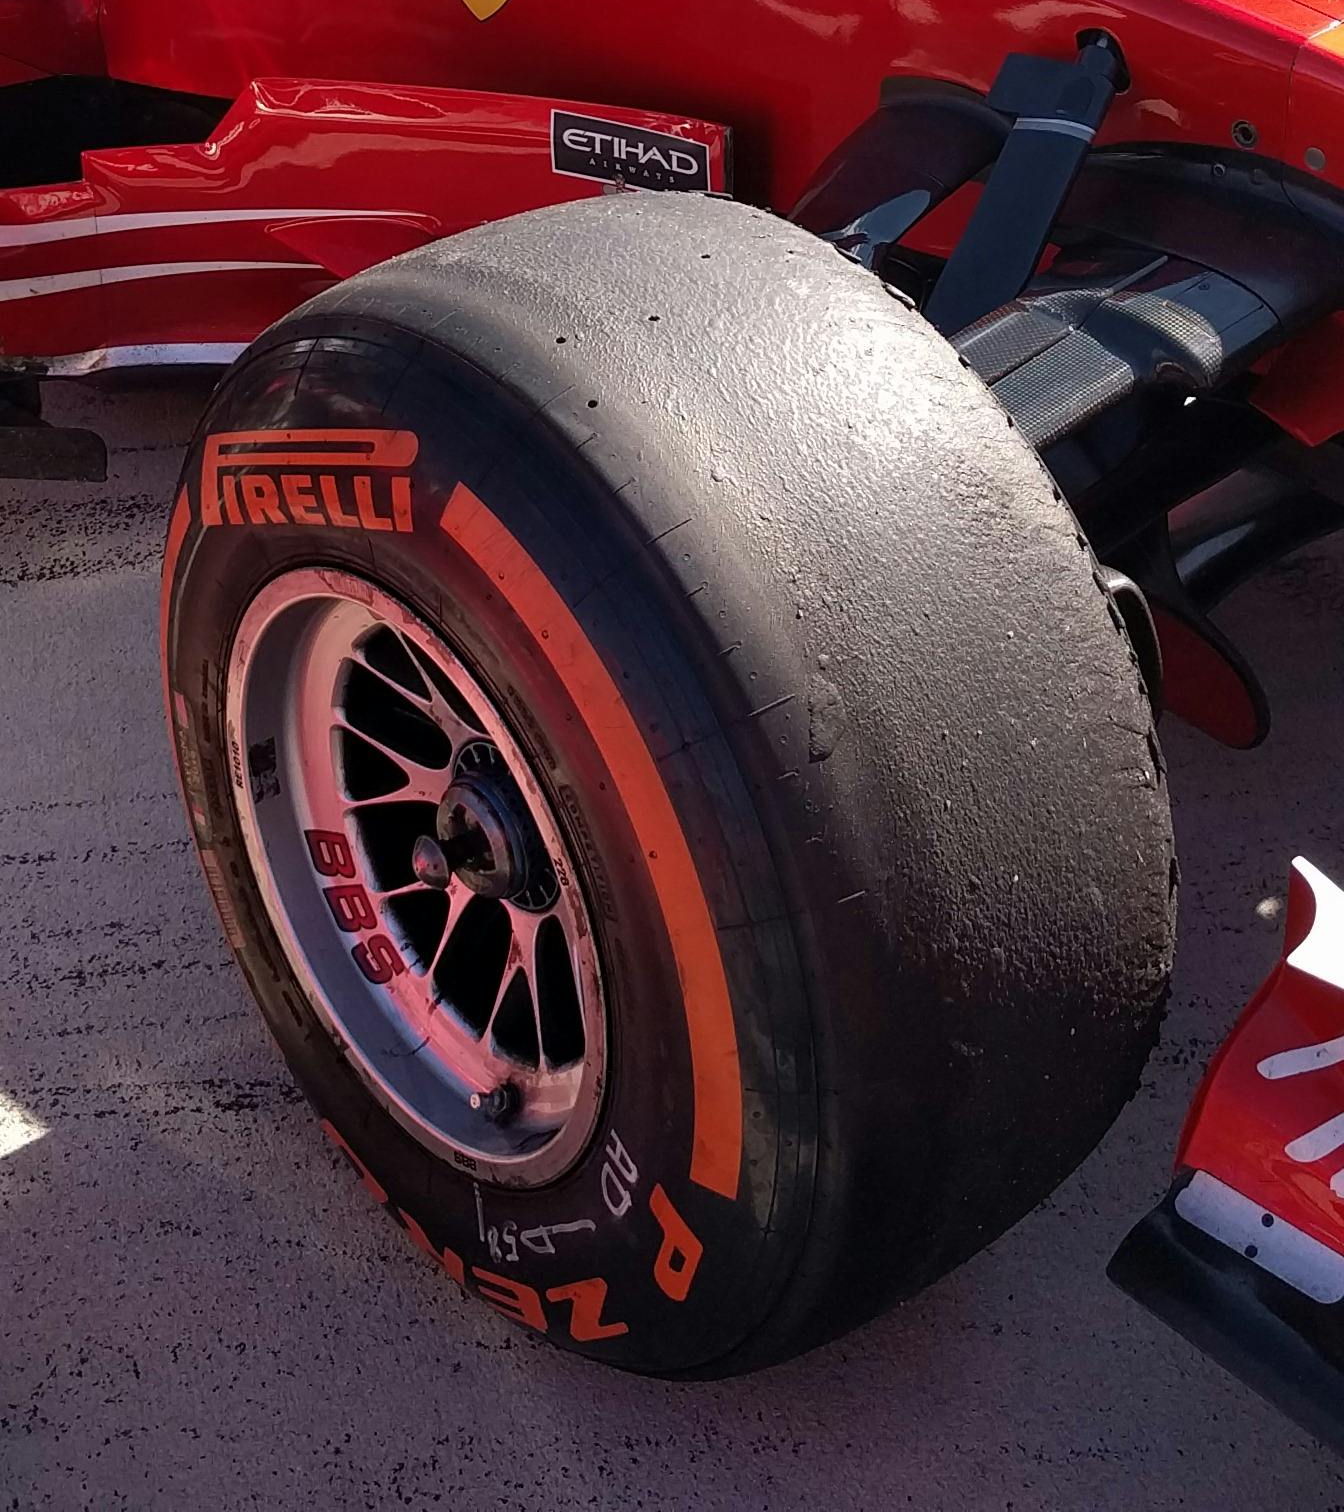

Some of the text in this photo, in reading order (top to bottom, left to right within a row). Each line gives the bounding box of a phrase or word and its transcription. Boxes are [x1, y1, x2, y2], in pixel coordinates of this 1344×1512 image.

[562, 128, 700, 176] ETIHAD
[588, 157, 676, 184] AIRWAYS
[200, 428, 420, 534] PIRELLI
[303, 828, 406, 985] BBS
